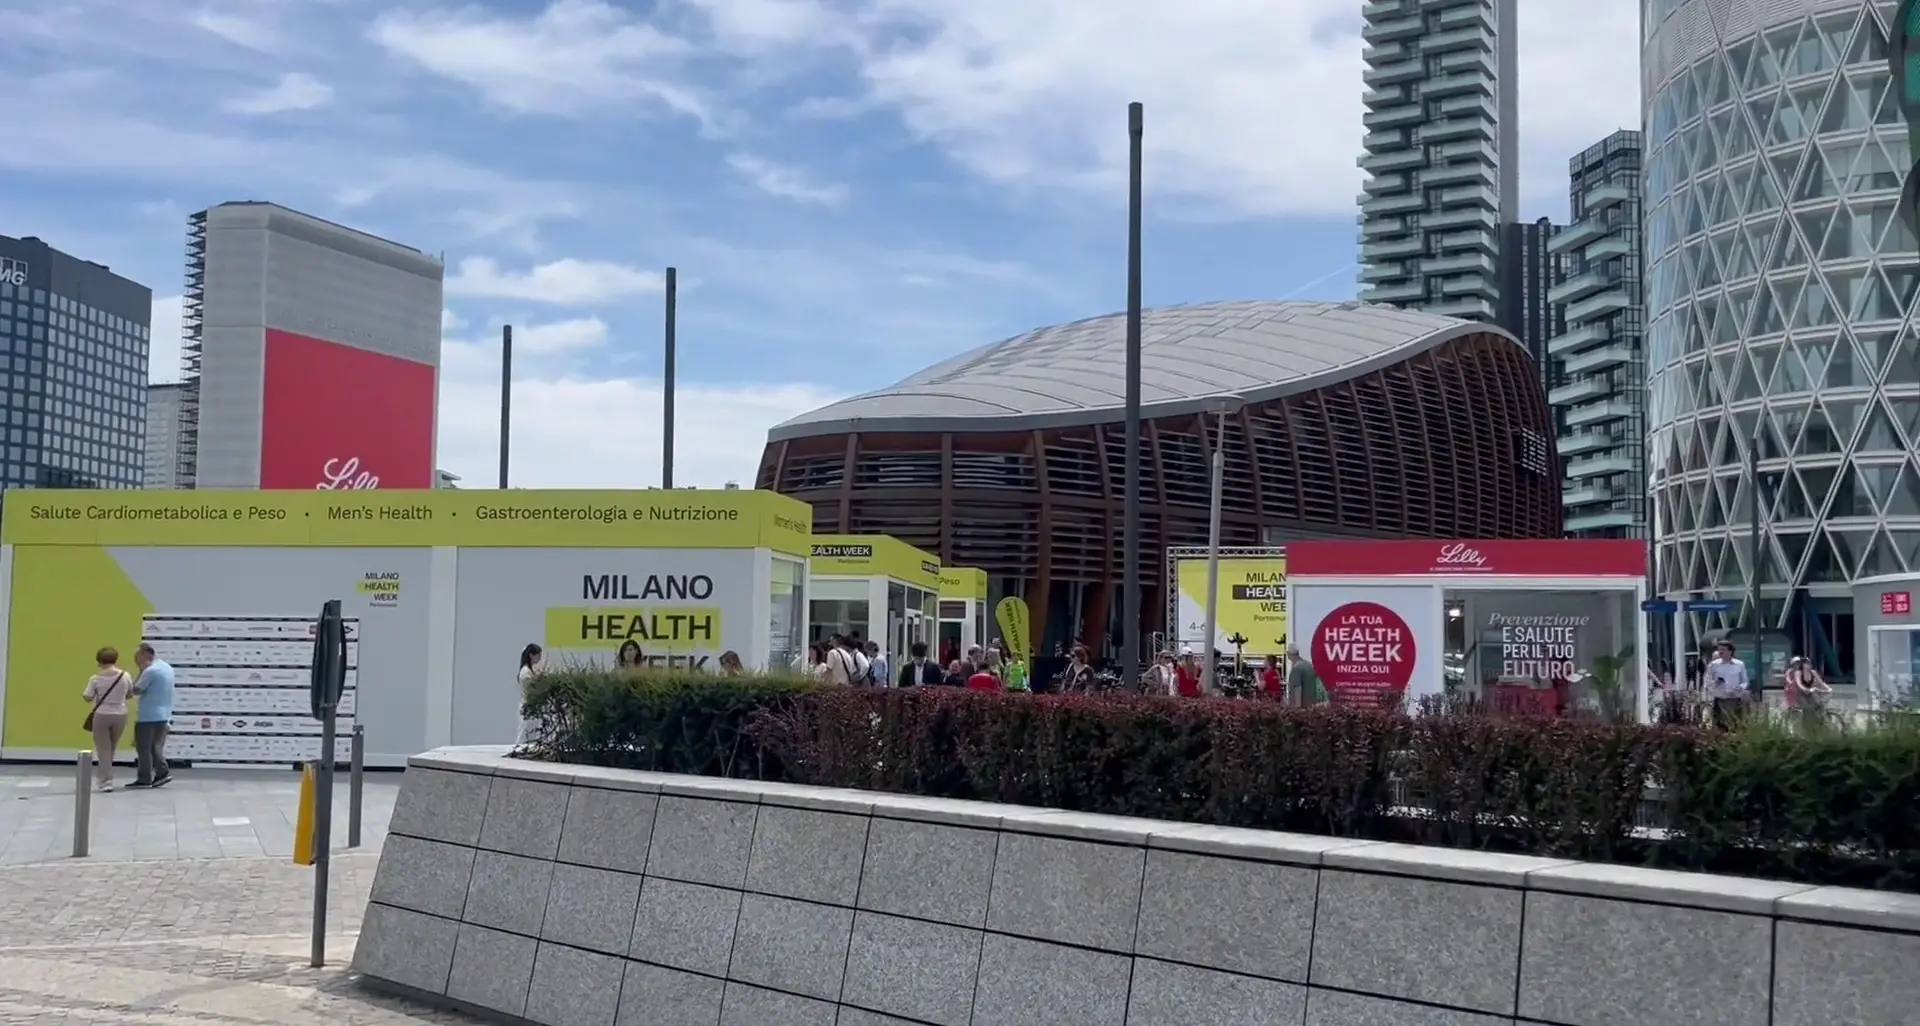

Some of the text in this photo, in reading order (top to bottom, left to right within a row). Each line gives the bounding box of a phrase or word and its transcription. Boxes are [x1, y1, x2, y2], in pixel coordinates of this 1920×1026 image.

[30, 505, 81, 520] Salute
[87, 505, 228, 520] Cardiometabolica
[233, 509, 242, 520] e
[249, 506, 287, 520] Peso
[379, 505, 433, 520] Health
[476, 505, 628, 524] Gastroenterologia
[633, 509, 643, 520] e
[650, 506, 738, 521] Nutrizione
[842, 547, 869, 555] WEEK
[1436, 542, 1487, 566] Lilly
[365, 572, 399, 580] MILANO
[583, 575, 713, 600] MILANO
[373, 593, 398, 601] WEEK
[1342, 616, 1383, 624] LA TUA
[1488, 613, 1590, 626] Prevenzione
[581, 615, 711, 640] HEALTH
[1325, 628, 1400, 641] HEALTH
[1502, 627, 1575, 643] E SALUTE
[1324, 643, 1402, 662] WEEK
[1503, 644, 1575, 659] PER IL TUO
[1337, 665, 1390, 674] INIZIA QUI
[1503, 661, 1576, 681] FUTURO
